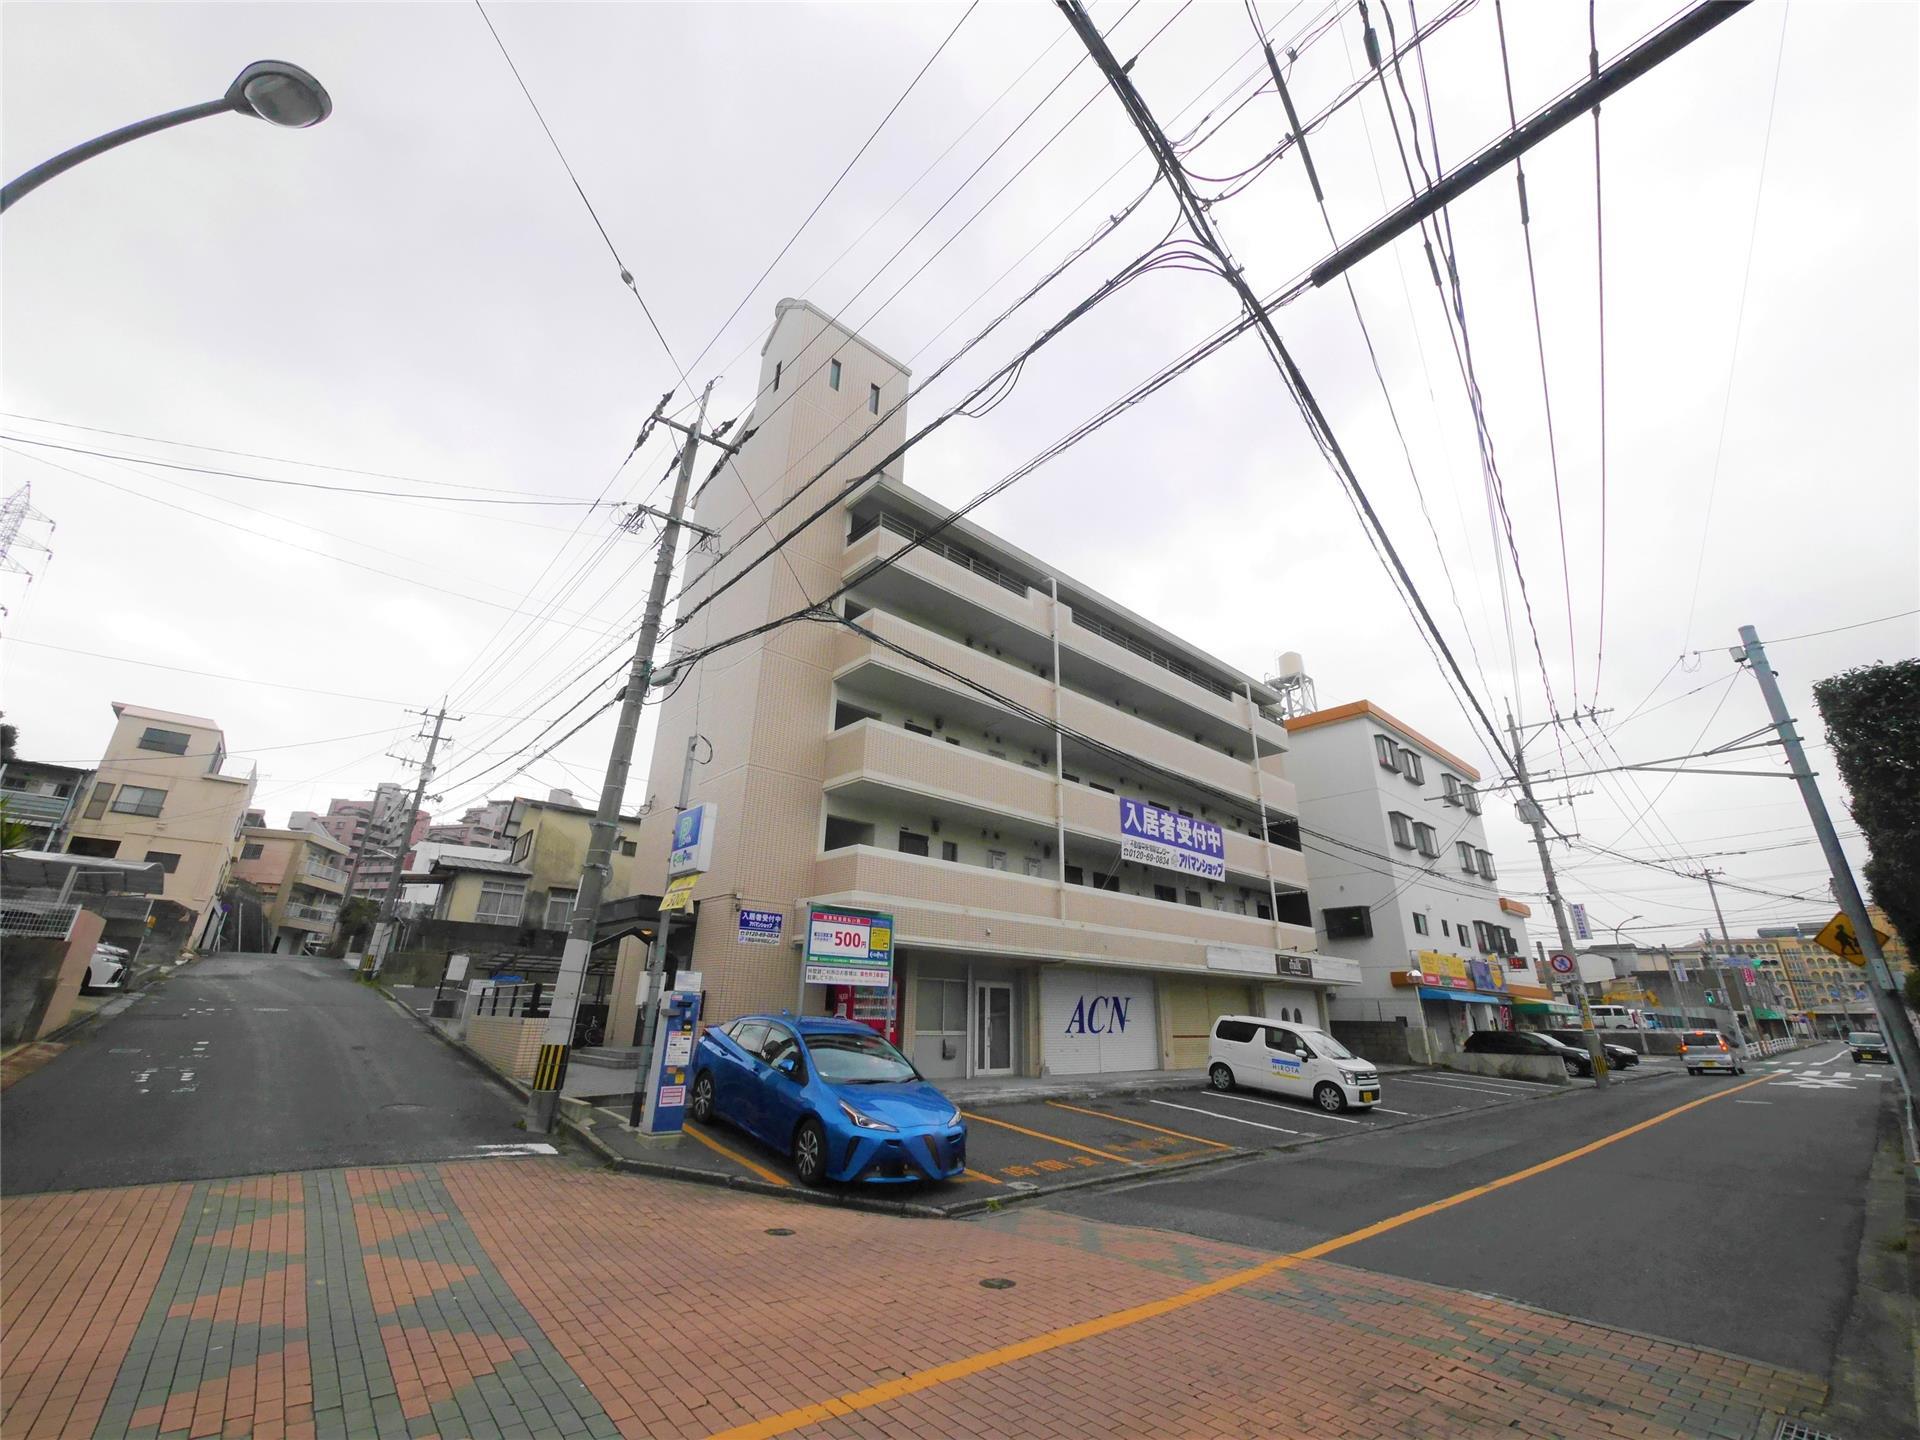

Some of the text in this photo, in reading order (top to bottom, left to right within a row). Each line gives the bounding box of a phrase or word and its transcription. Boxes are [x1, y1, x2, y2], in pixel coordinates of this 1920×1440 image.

[1124, 802, 1221, 853] 入居者受付中
[1178, 853, 1223, 877] アパマンショップ
[742, 912, 782, 923] 入居者受付中
[1064, 995, 1131, 1034] ACN
[1272, 1063, 1299, 1074] HIROTA
